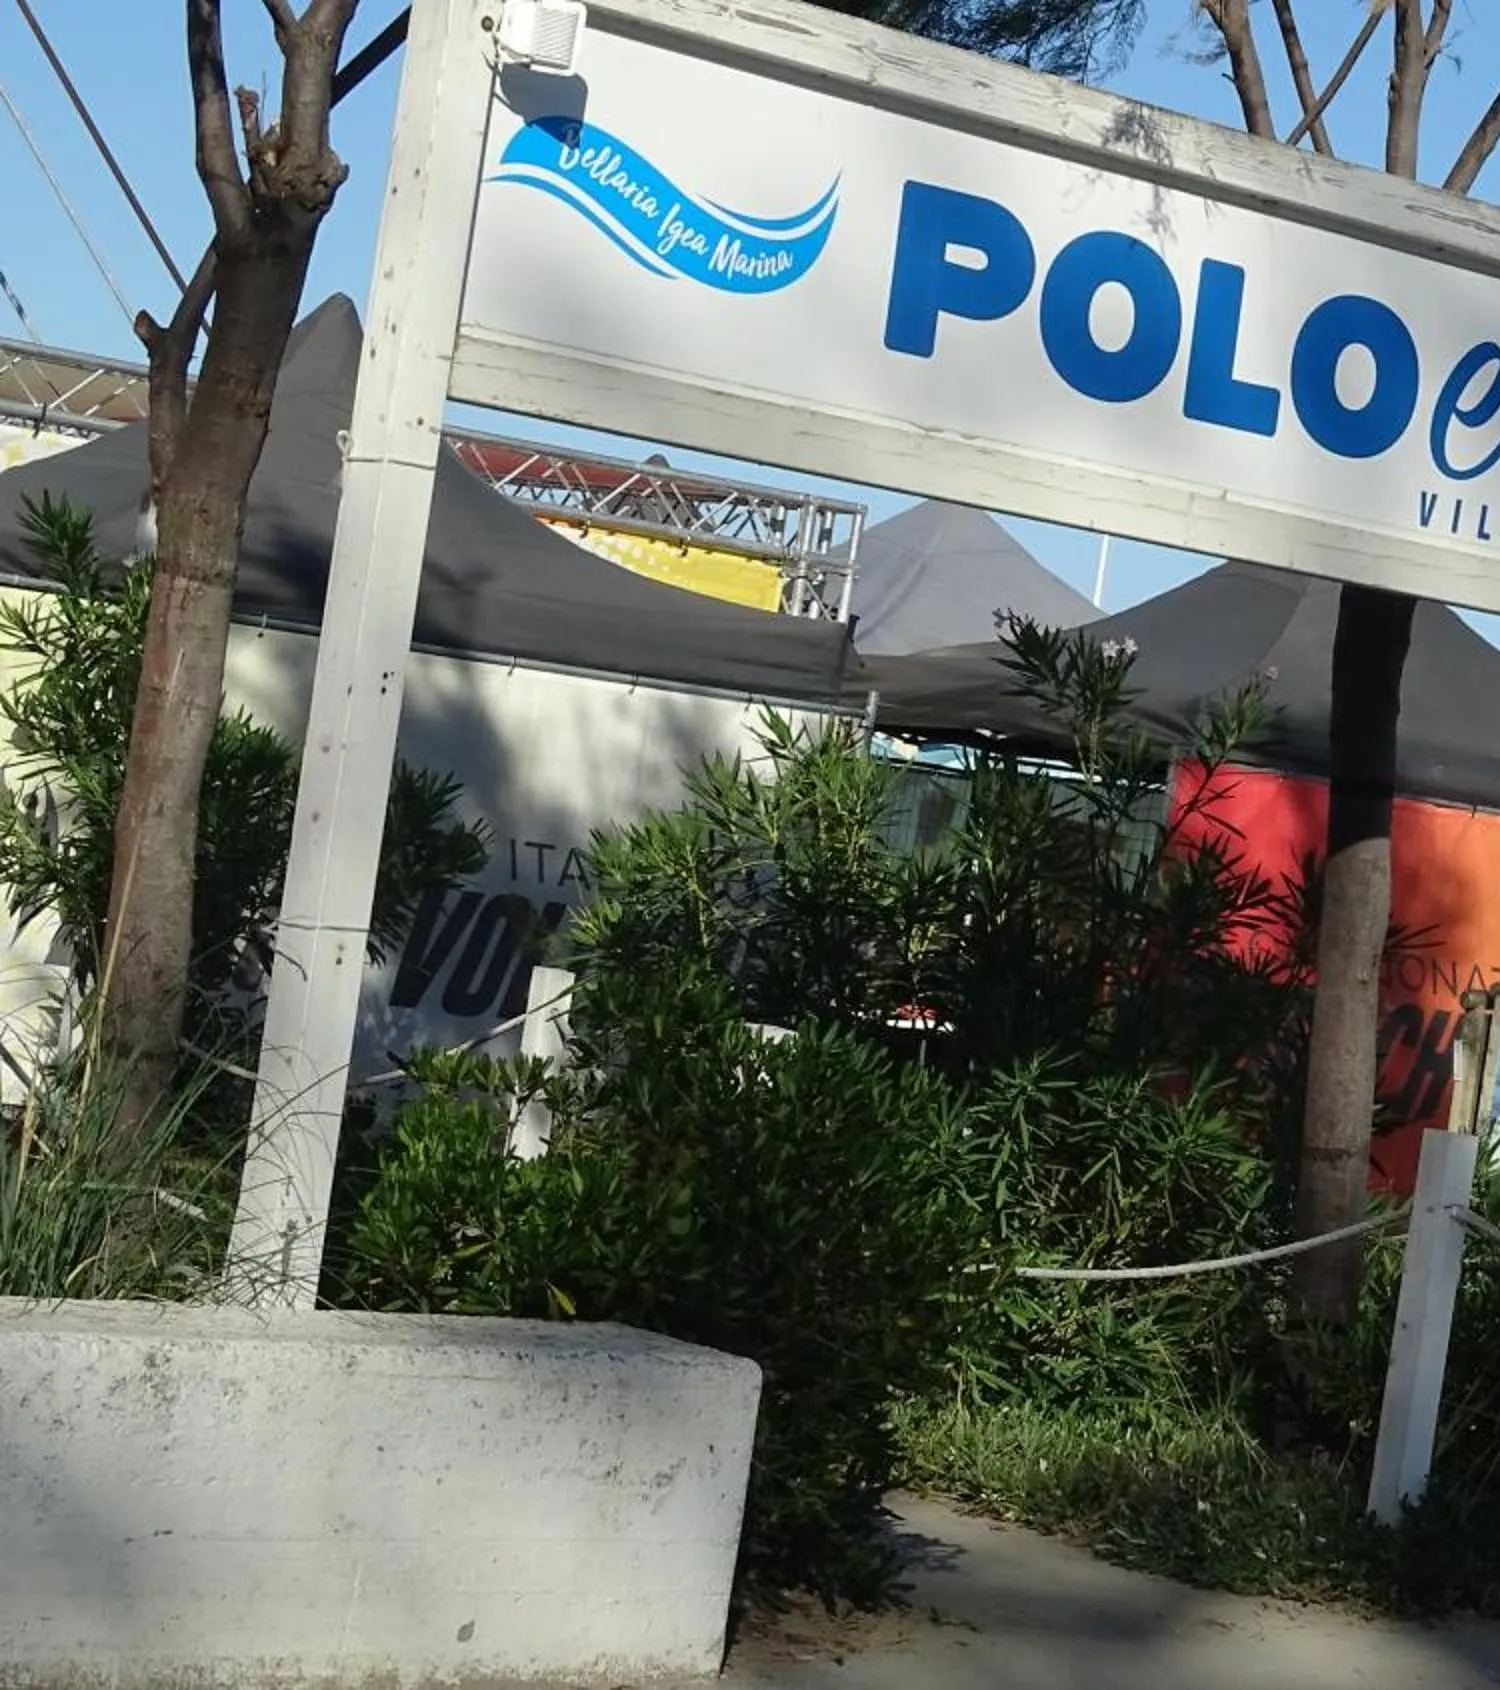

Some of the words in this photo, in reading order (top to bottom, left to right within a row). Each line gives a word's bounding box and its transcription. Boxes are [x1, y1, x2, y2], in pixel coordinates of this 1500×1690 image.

[558, 122, 658, 219] Bellaria
[657, 203, 709, 255] Igea
[708, 234, 793, 280] Marina
[883, 179, 1420, 459] POLO
